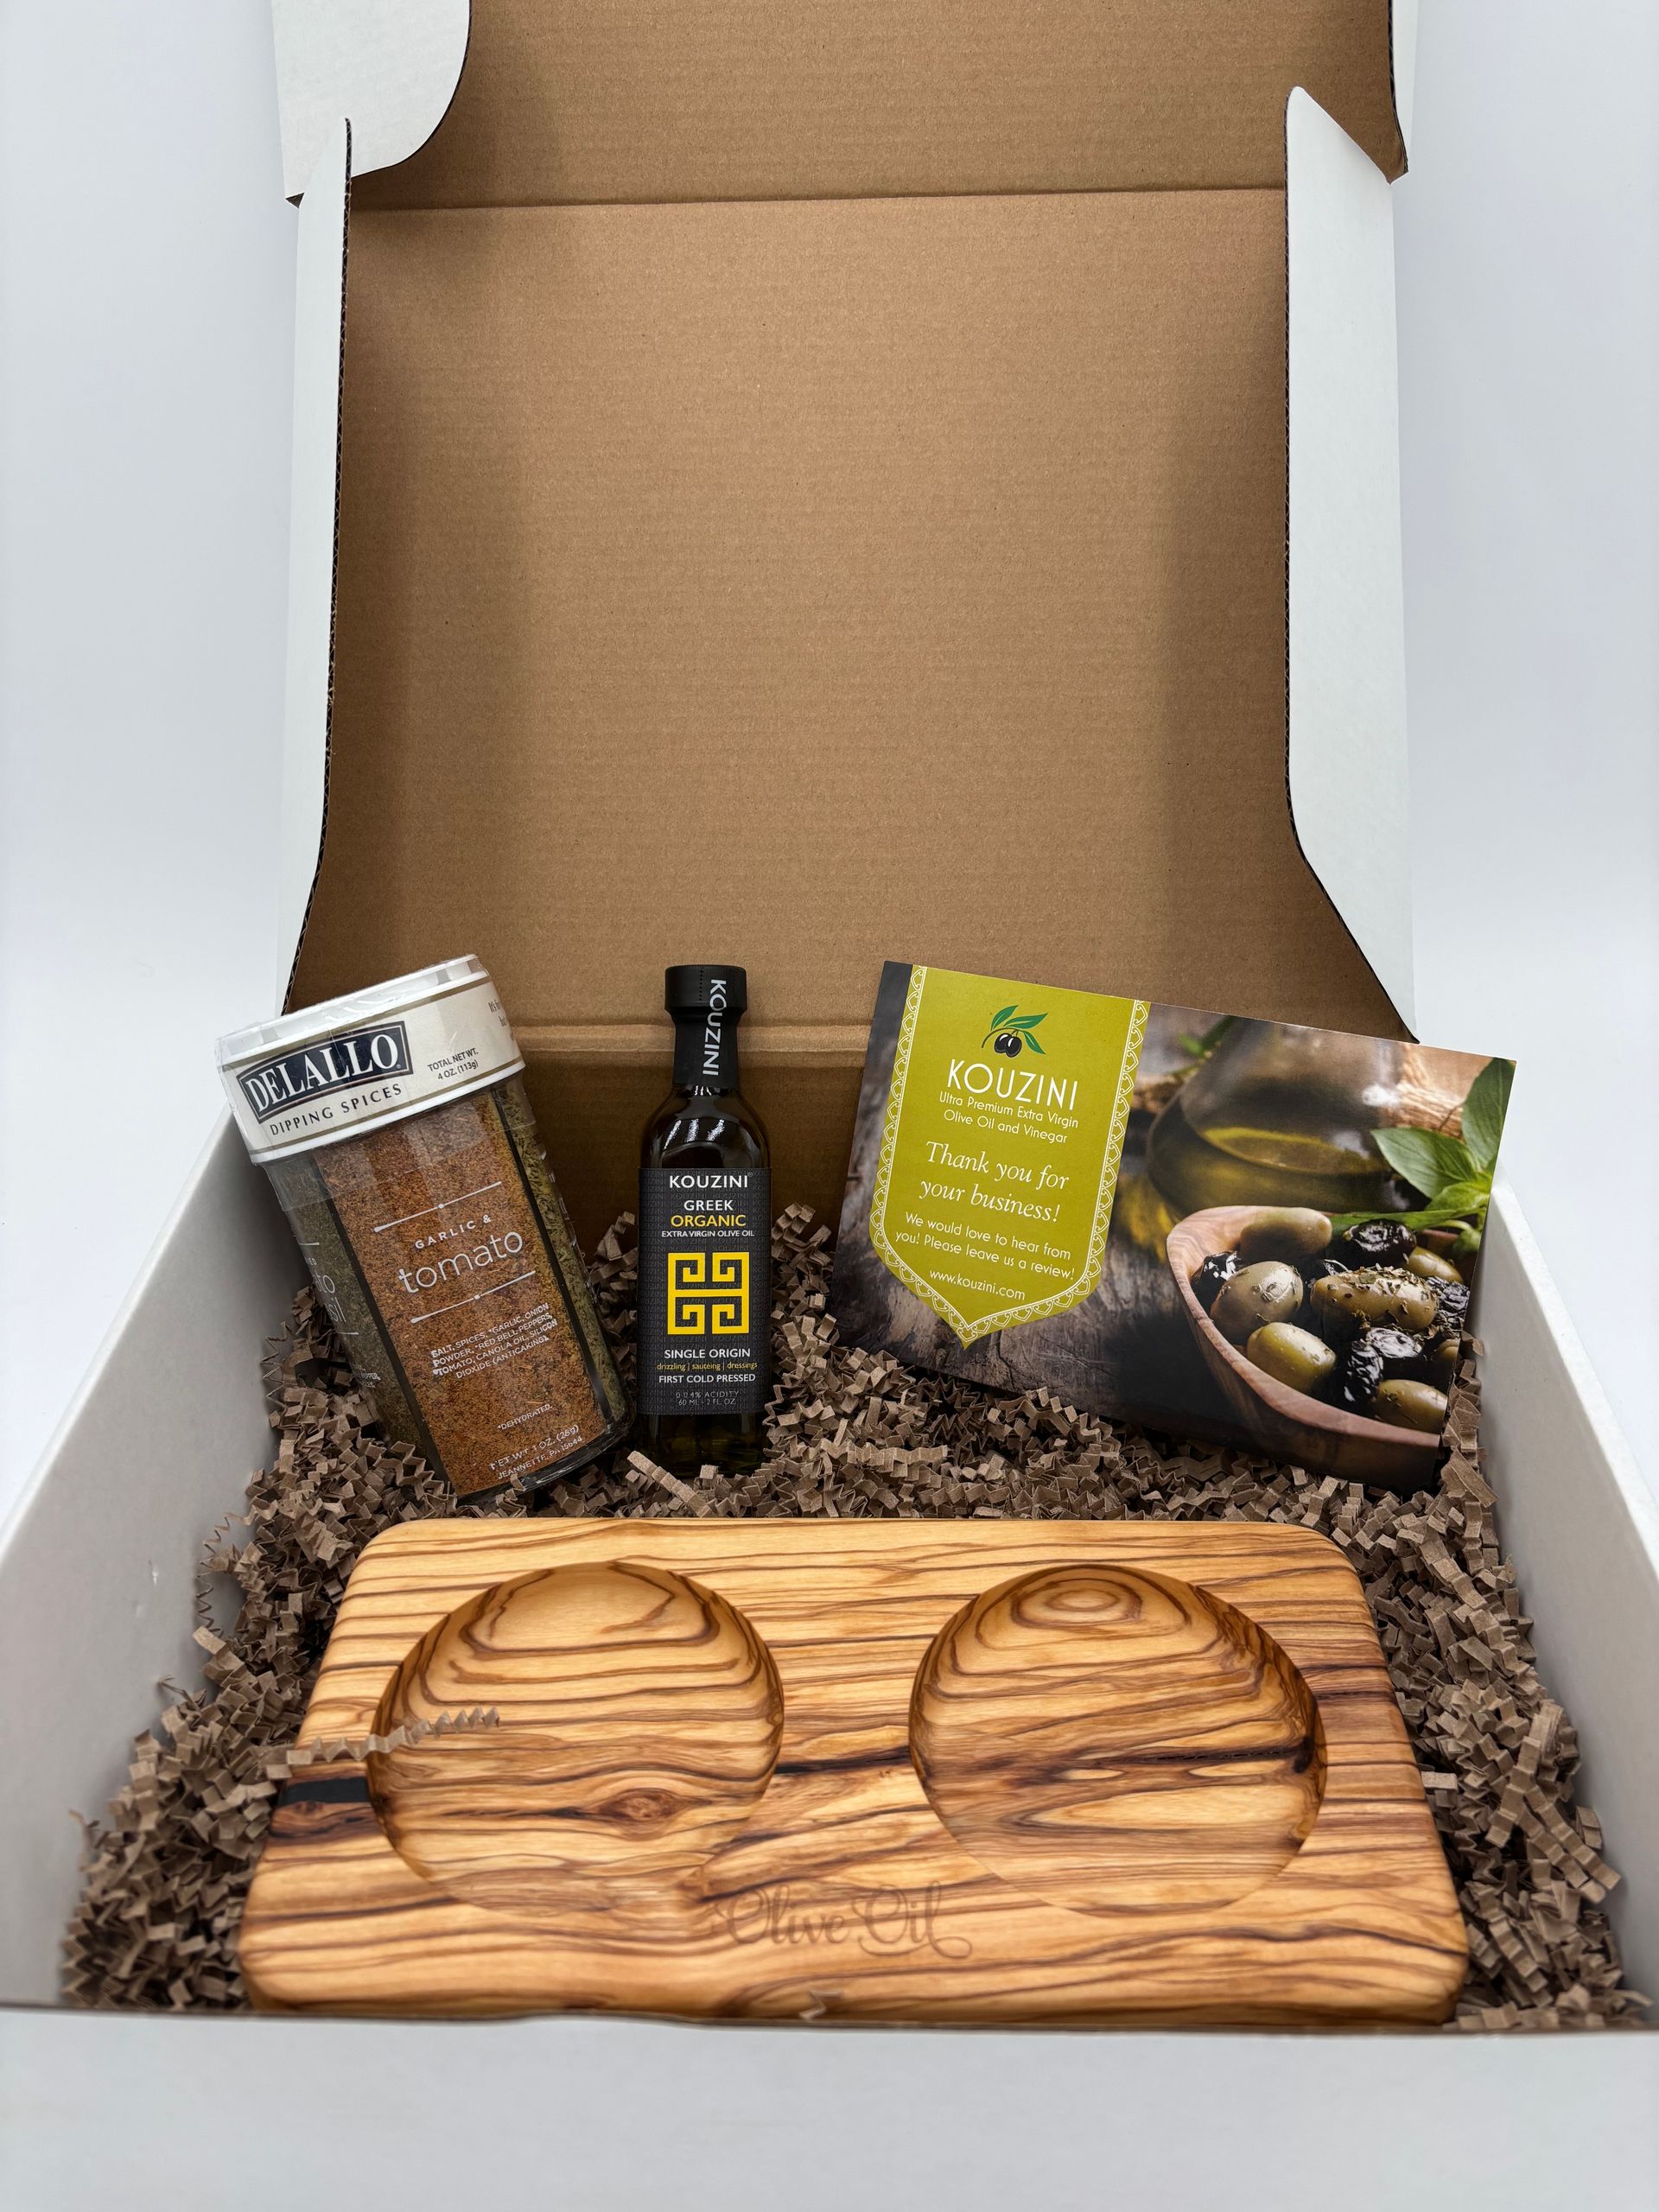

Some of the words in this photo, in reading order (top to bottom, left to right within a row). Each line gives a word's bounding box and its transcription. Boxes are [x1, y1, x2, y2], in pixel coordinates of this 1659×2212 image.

[702, 979, 728, 1076] KOUZINI
[245, 1033, 399, 1112] DELALLO
[427, 1058, 453, 1071] TOTAL
[452, 1052, 466, 1063] NET
[465, 1047, 479, 1058] WT.
[443, 1068, 458, 1078] OZ.
[457, 1058, 479, 1074] (113g)
[947, 1058, 1078, 1111] KOUZINI
[270, 1107, 334, 1135] DIPPING
[340, 1083, 402, 1114] SPICES
[939, 1090, 963, 1107] Ultra
[967, 1096, 1014, 1116] Premium
[1017, 1106, 1044, 1122] Extra
[1047, 1111, 1079, 1129] Virgin
[944, 1109, 973, 1126] Olive
[977, 1116, 995, 1129] Oil
[997, 1120, 1020, 1136] and
[1023, 1123, 1068, 1144] Vinegar
[669, 1175, 748, 1189] KOUZINI
[925, 1141, 989, 1174] Thank
[994, 1162, 1033, 1184] you
[1035, 1165, 1070, 1191] for
[683, 1199, 734, 1211] GREEK
[918, 1180, 966, 1202] your
[970, 1183, 1061, 1224] business!
[415, 1220, 476, 1249] GARLIC
[482, 1214, 492, 1224] &
[670, 1214, 747, 1228] ORGANIC
[906, 1211, 924, 1228] We
[927, 1219, 962, 1236] would
[965, 1224, 991, 1243] love
[995, 1232, 1008, 1246] to
[1011, 1234, 1039, 1253] hear
[1043, 1242, 1071, 1261] from
[398, 1231, 523, 1294] tomato
[895, 1230, 920, 1244] you!
[924, 1234, 962, 1255] Please
[966, 1246, 1000, 1263] leave
[1003, 1255, 1014, 1267] us
[1018, 1259, 1027, 1270] a
[1030, 1261, 1075, 1281] review!
[929, 1268, 1026, 1301] www.kouzini.com
[430, 1344, 455, 1358] SALT,
[524, 1302, 550, 1319] ONION
[476, 1342, 512, 1361] CANOLA
[530, 1319, 558, 1338] SILICON
[497, 1330, 518, 1342] BELL
[518, 1312, 553, 1332] PEPPERS,
[455, 1359, 492, 1379] DIOXIDE
[657, 1363, 686, 1372] drizzling
[727, 1361, 758, 1370] dressings
[664, 1349, 706, 1359] SINGLE
[709, 1348, 751, 1358] ORIGIN
[658, 1375, 684, 1383] FIRST
[686, 1375, 715, 1383] COLD
[716, 1373, 756, 1382] PRESSED
[714, 1884, 851, 1945] Olive
[850, 1880, 972, 1959] Oil
